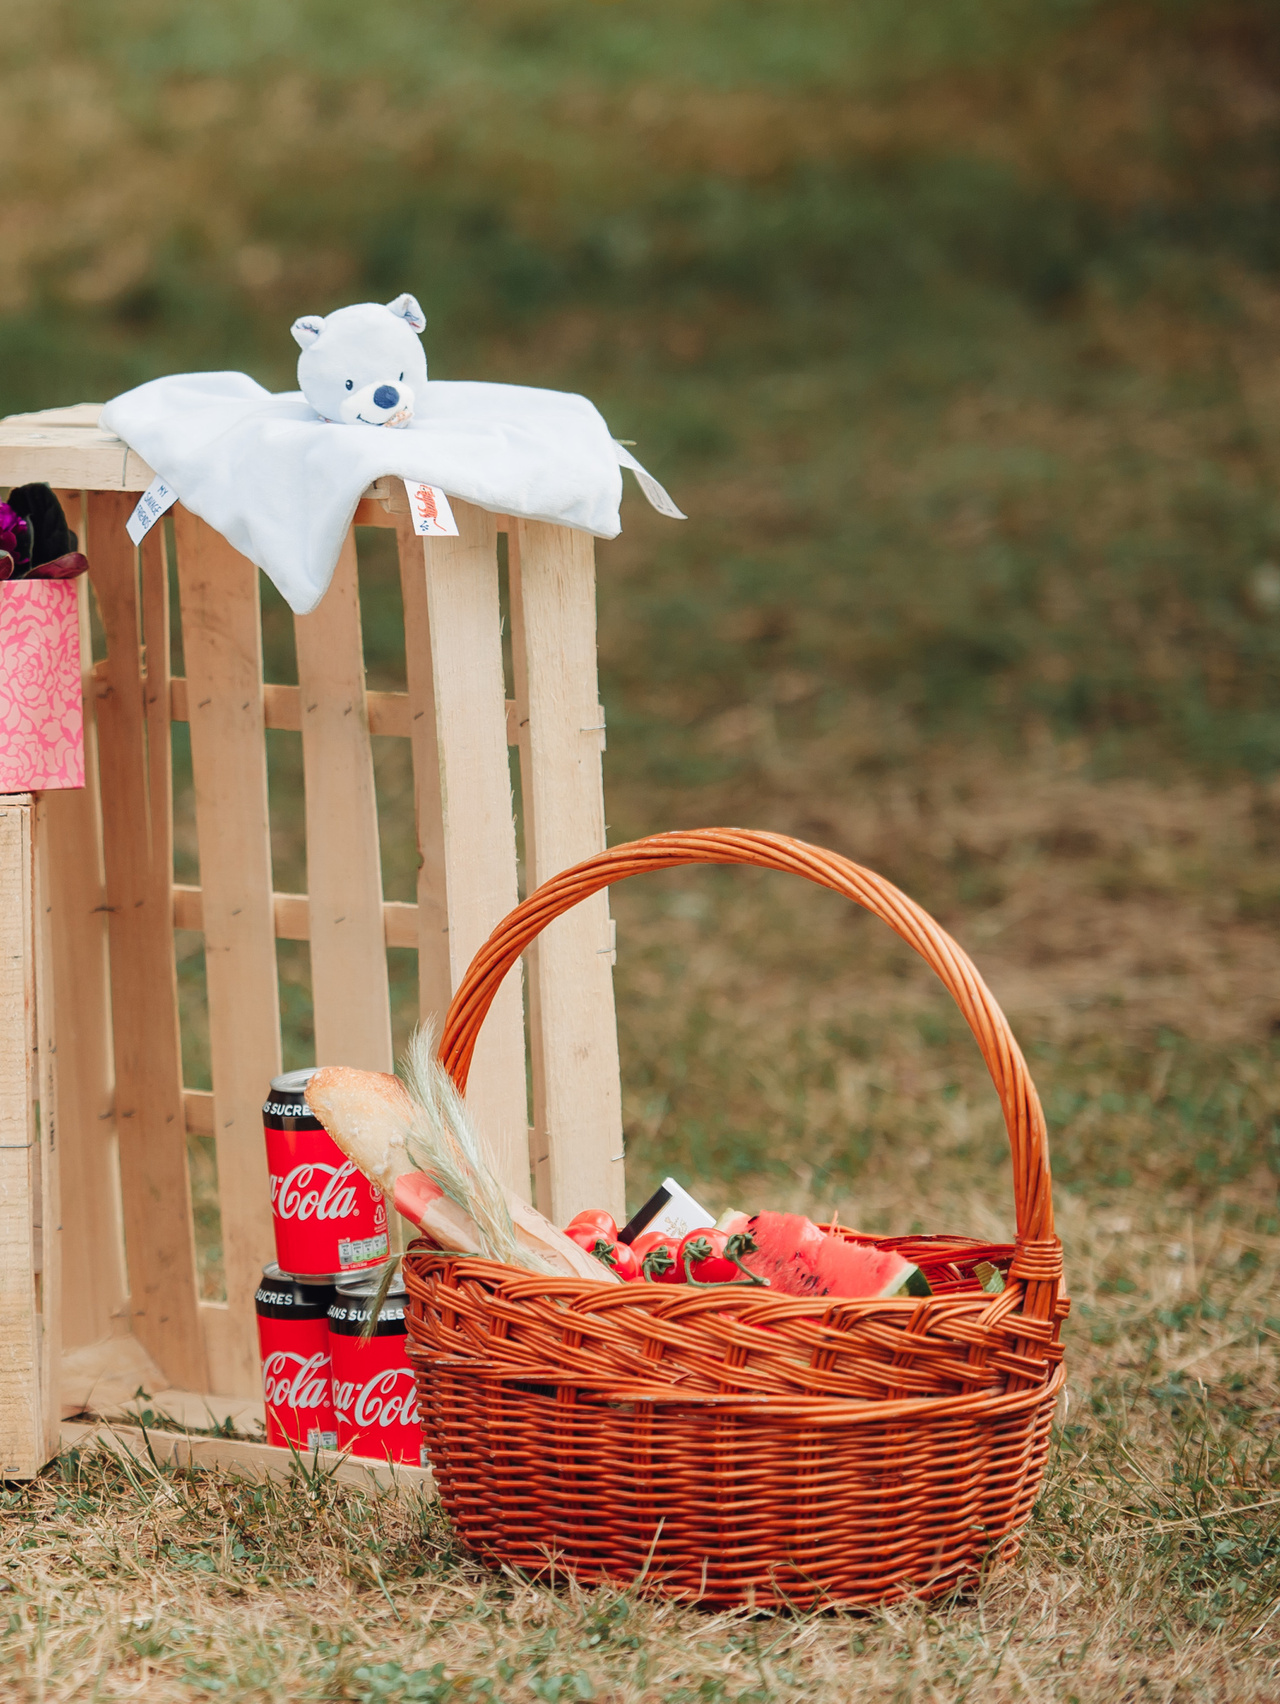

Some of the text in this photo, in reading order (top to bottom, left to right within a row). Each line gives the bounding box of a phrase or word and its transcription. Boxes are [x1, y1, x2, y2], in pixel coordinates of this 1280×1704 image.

[157, 485, 168, 497] MY
[144, 492, 162, 516] SAVAGE
[136, 504, 151, 529] FRIENDS
[255, 1289, 293, 1305] SUCRES
